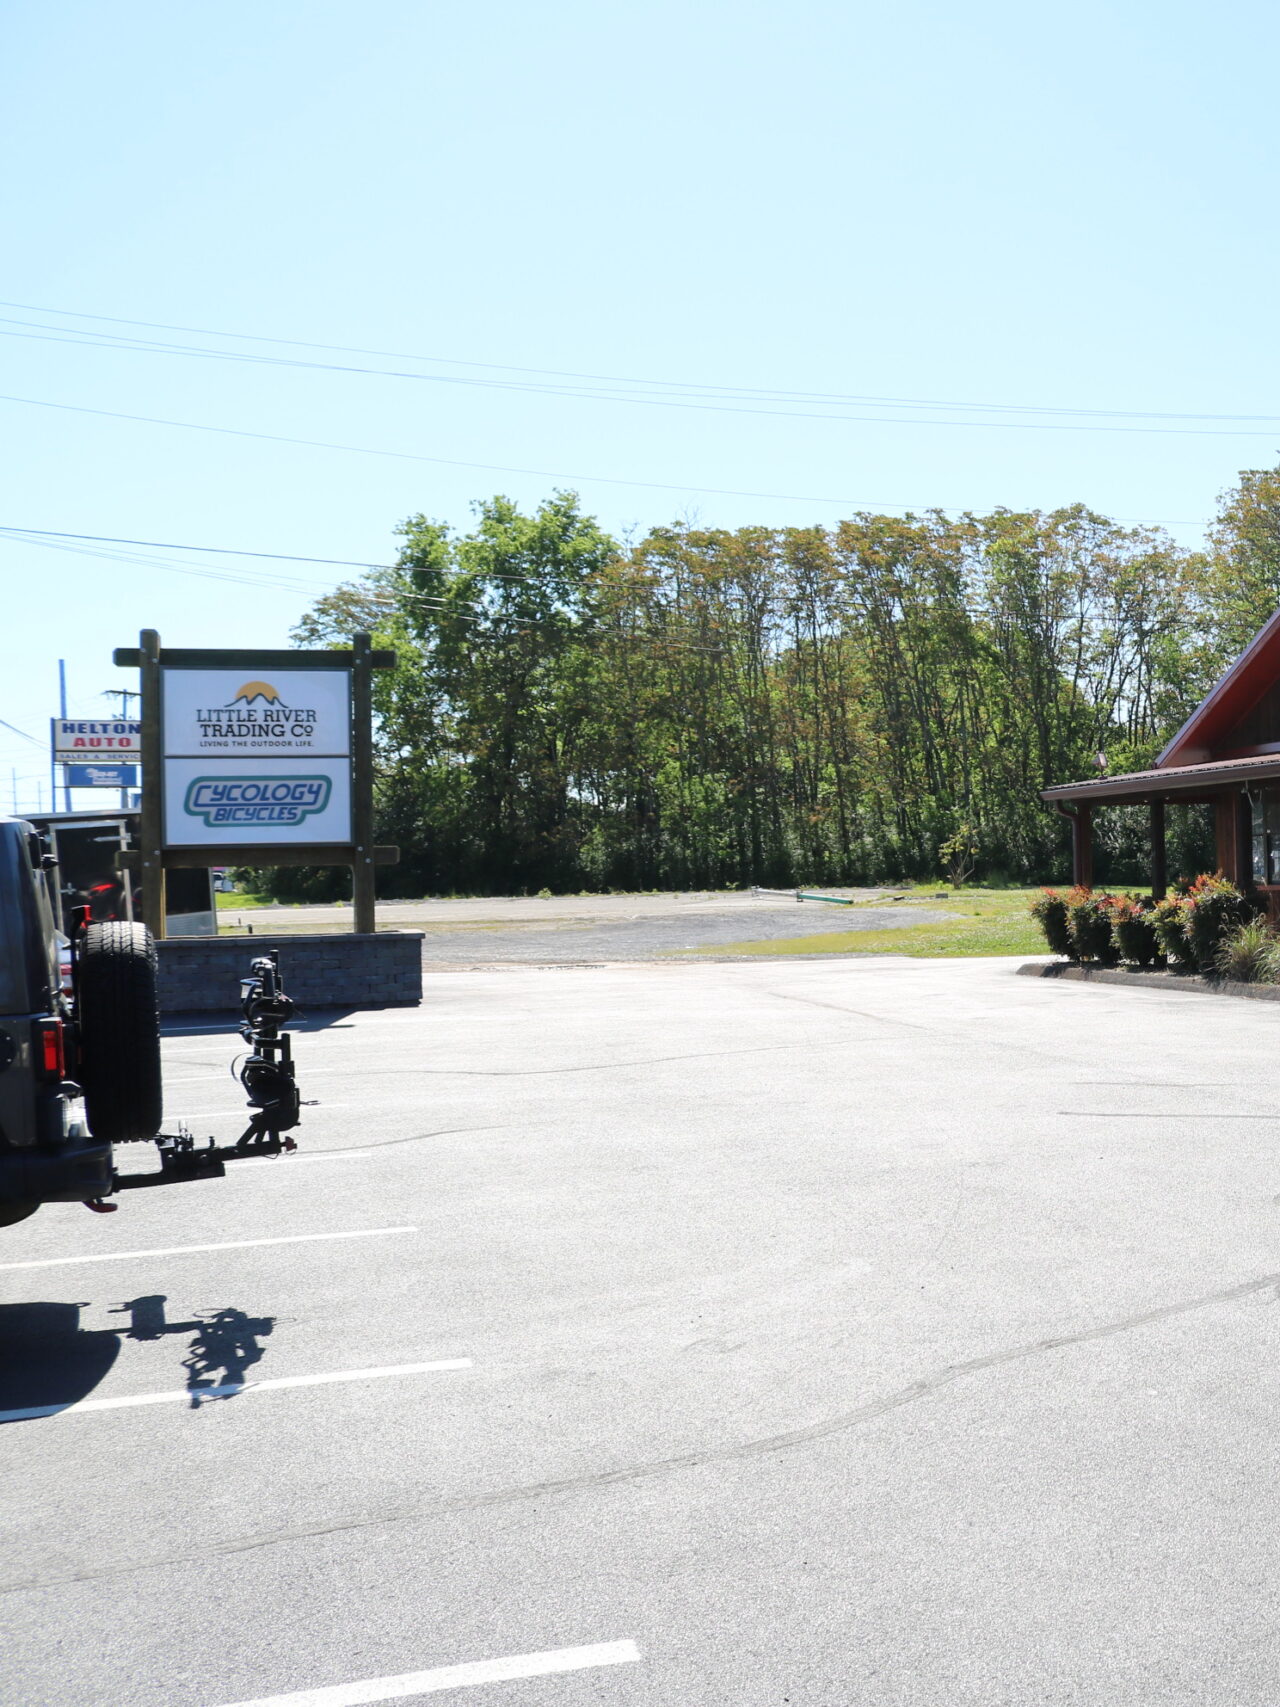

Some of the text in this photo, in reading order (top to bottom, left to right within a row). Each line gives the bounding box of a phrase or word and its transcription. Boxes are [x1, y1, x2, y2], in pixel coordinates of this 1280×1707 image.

[196, 709, 317, 723] LITTLE RIVER
[62, 723, 141, 734] HELTON
[200, 724, 285, 737] TRADING
[73, 737, 132, 747] AUTO
[193, 783, 323, 808] CYCOLOGY
[213, 807, 298, 822] BICYCLES
